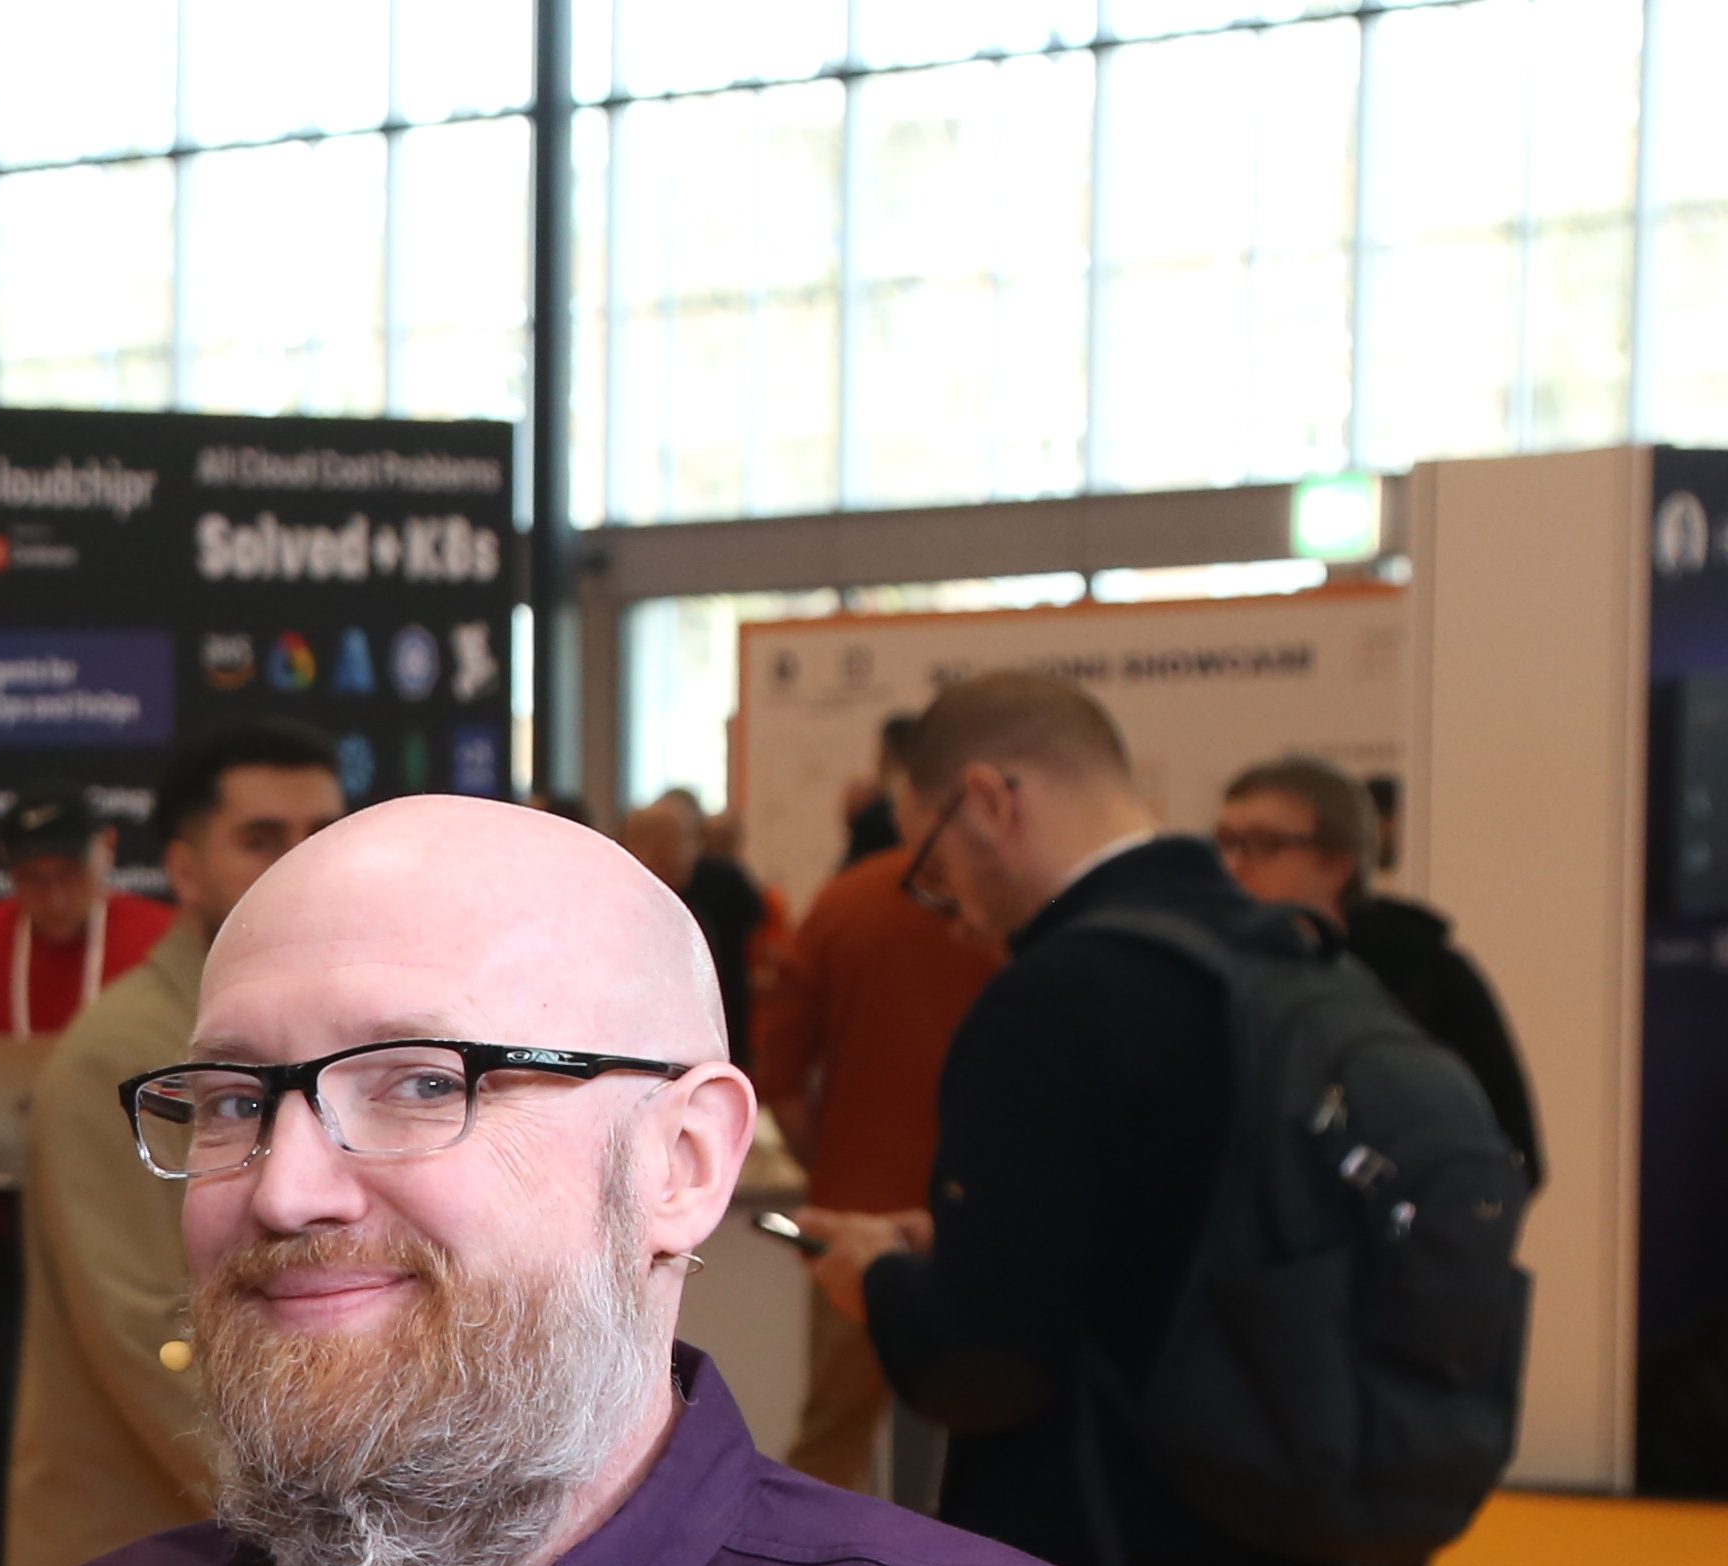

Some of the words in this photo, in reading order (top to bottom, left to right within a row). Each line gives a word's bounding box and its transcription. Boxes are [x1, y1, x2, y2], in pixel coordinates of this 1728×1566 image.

[196, 447, 234, 486] All
[237, 449, 311, 487] Cloud
[317, 452, 375, 488] Cost
[378, 453, 500, 489] Problems
[196, 511, 369, 581] Solved
[403, 517, 499, 582] K8s
[1119, 644, 1314, 680] SHOWCASE
